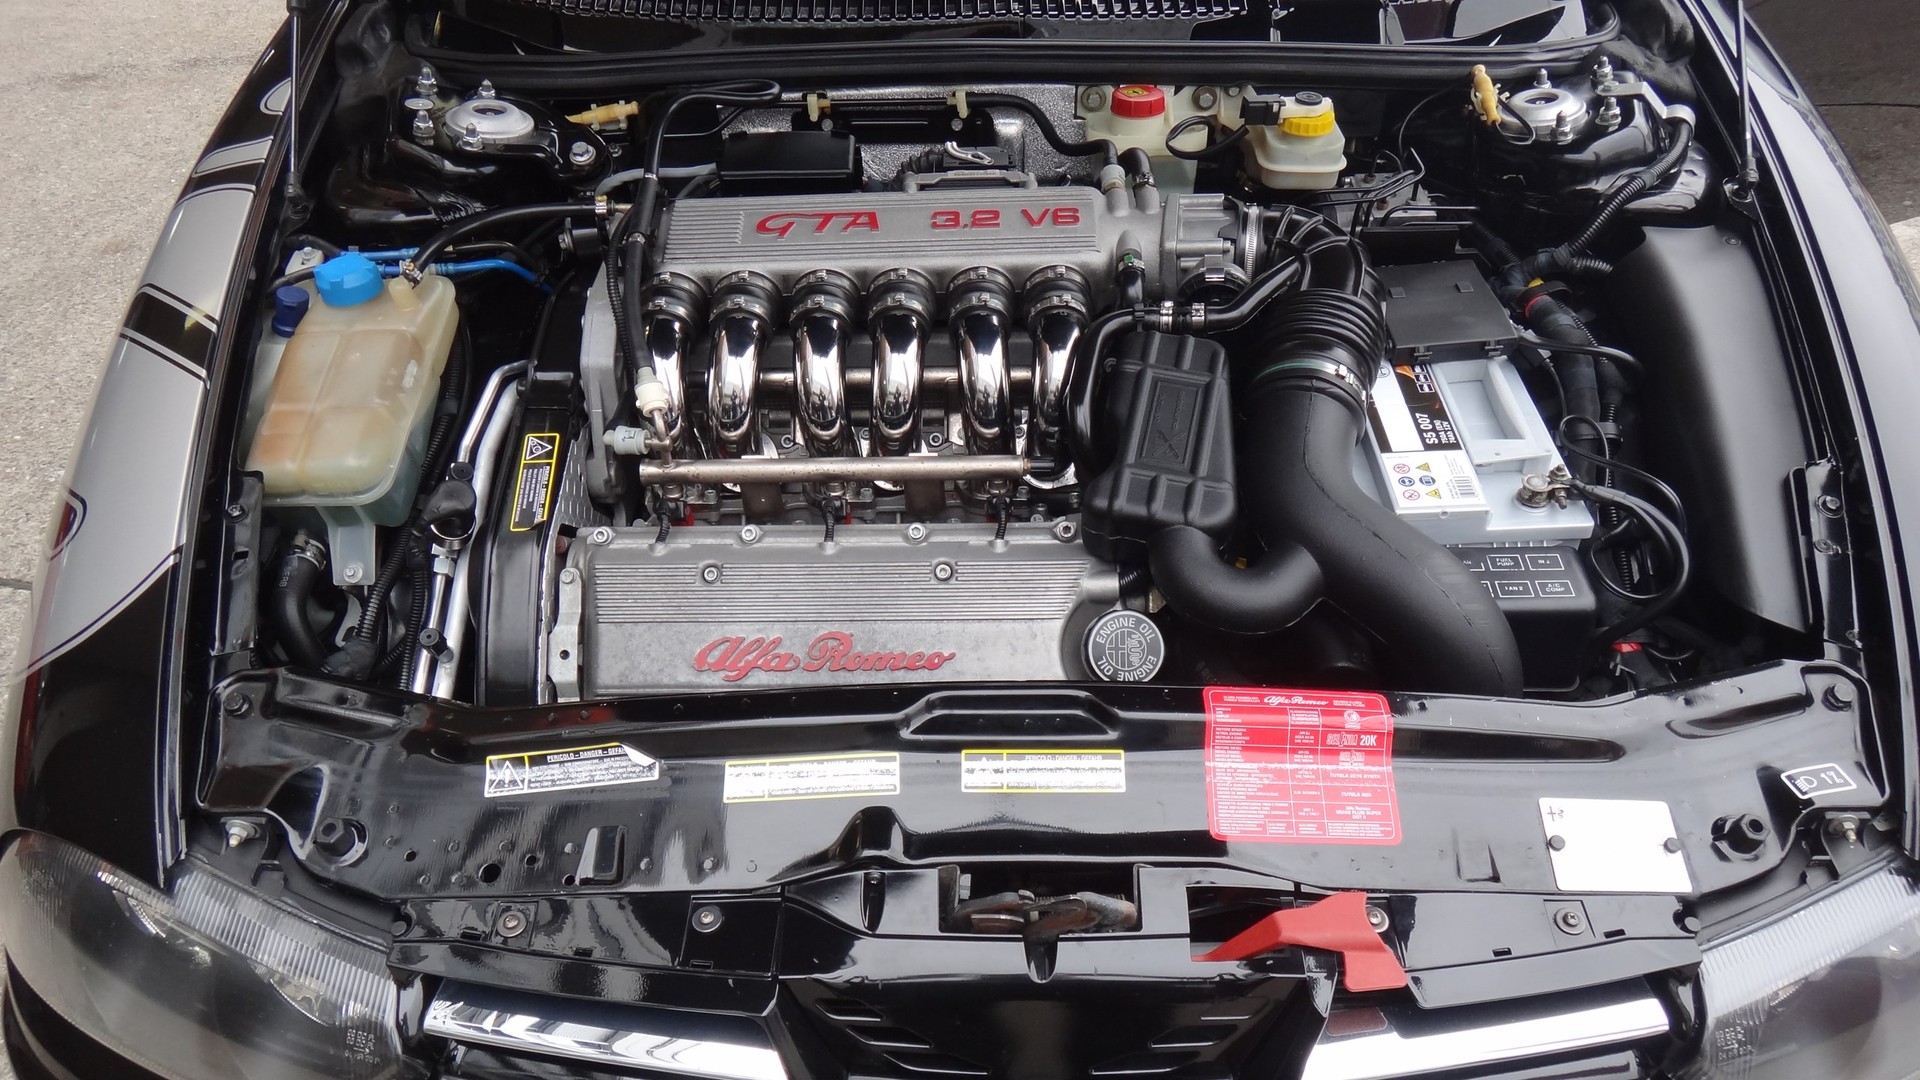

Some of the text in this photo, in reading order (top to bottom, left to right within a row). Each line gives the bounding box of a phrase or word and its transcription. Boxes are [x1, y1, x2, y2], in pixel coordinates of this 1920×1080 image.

[756, 207, 1080, 239] GTA 3.2 V6
[1415, 412, 1439, 444] S5 007
[1096, 617, 1155, 644] ENGINE OIL
[693, 631, 956, 682] Alfa Romeo
[1098, 655, 1157, 681] ENGINE OIL
[1360, 735, 1377, 746] 20K
